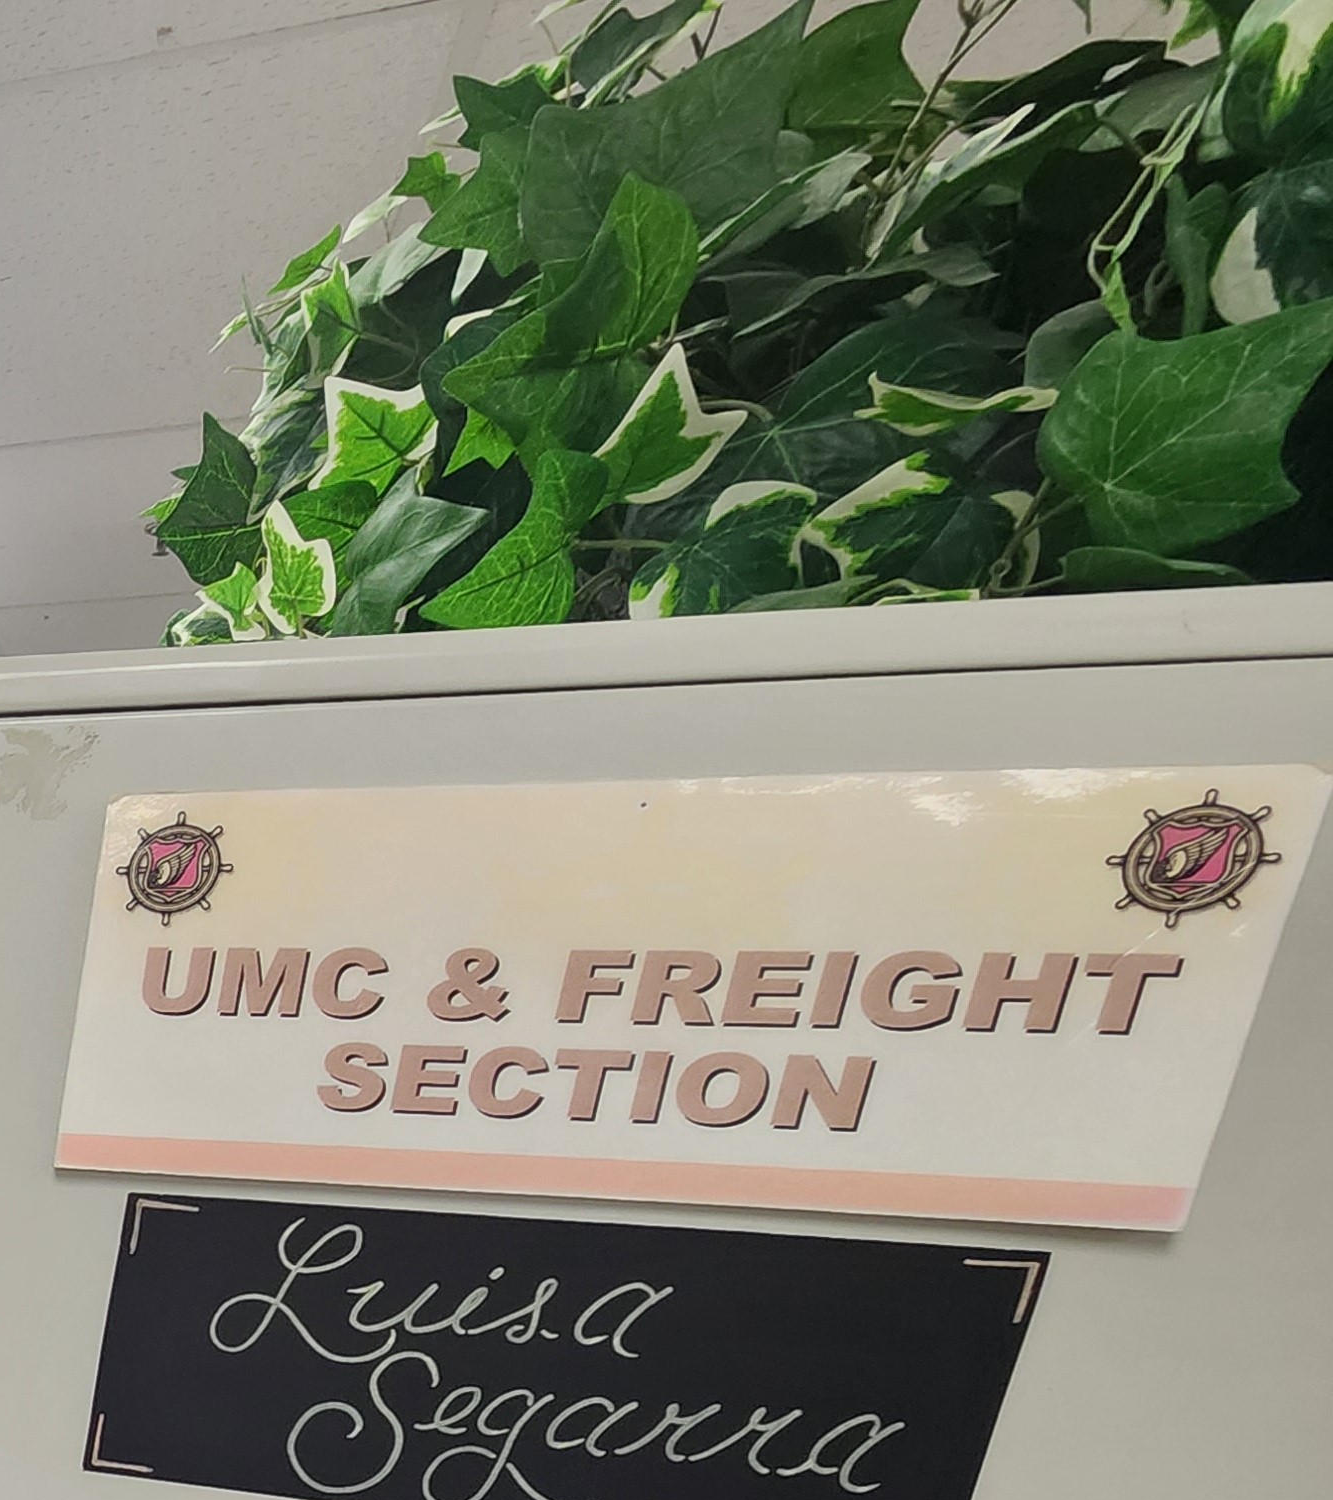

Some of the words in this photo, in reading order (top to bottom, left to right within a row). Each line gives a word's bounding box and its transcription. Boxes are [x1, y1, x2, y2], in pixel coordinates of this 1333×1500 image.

[139, 945, 389, 1020] UMC
[425, 947, 511, 1024] &
[554, 950, 1185, 1037] FREIGHT
[316, 1042, 877, 1133] SECTION
[208, 1216, 676, 1369] Luisa
